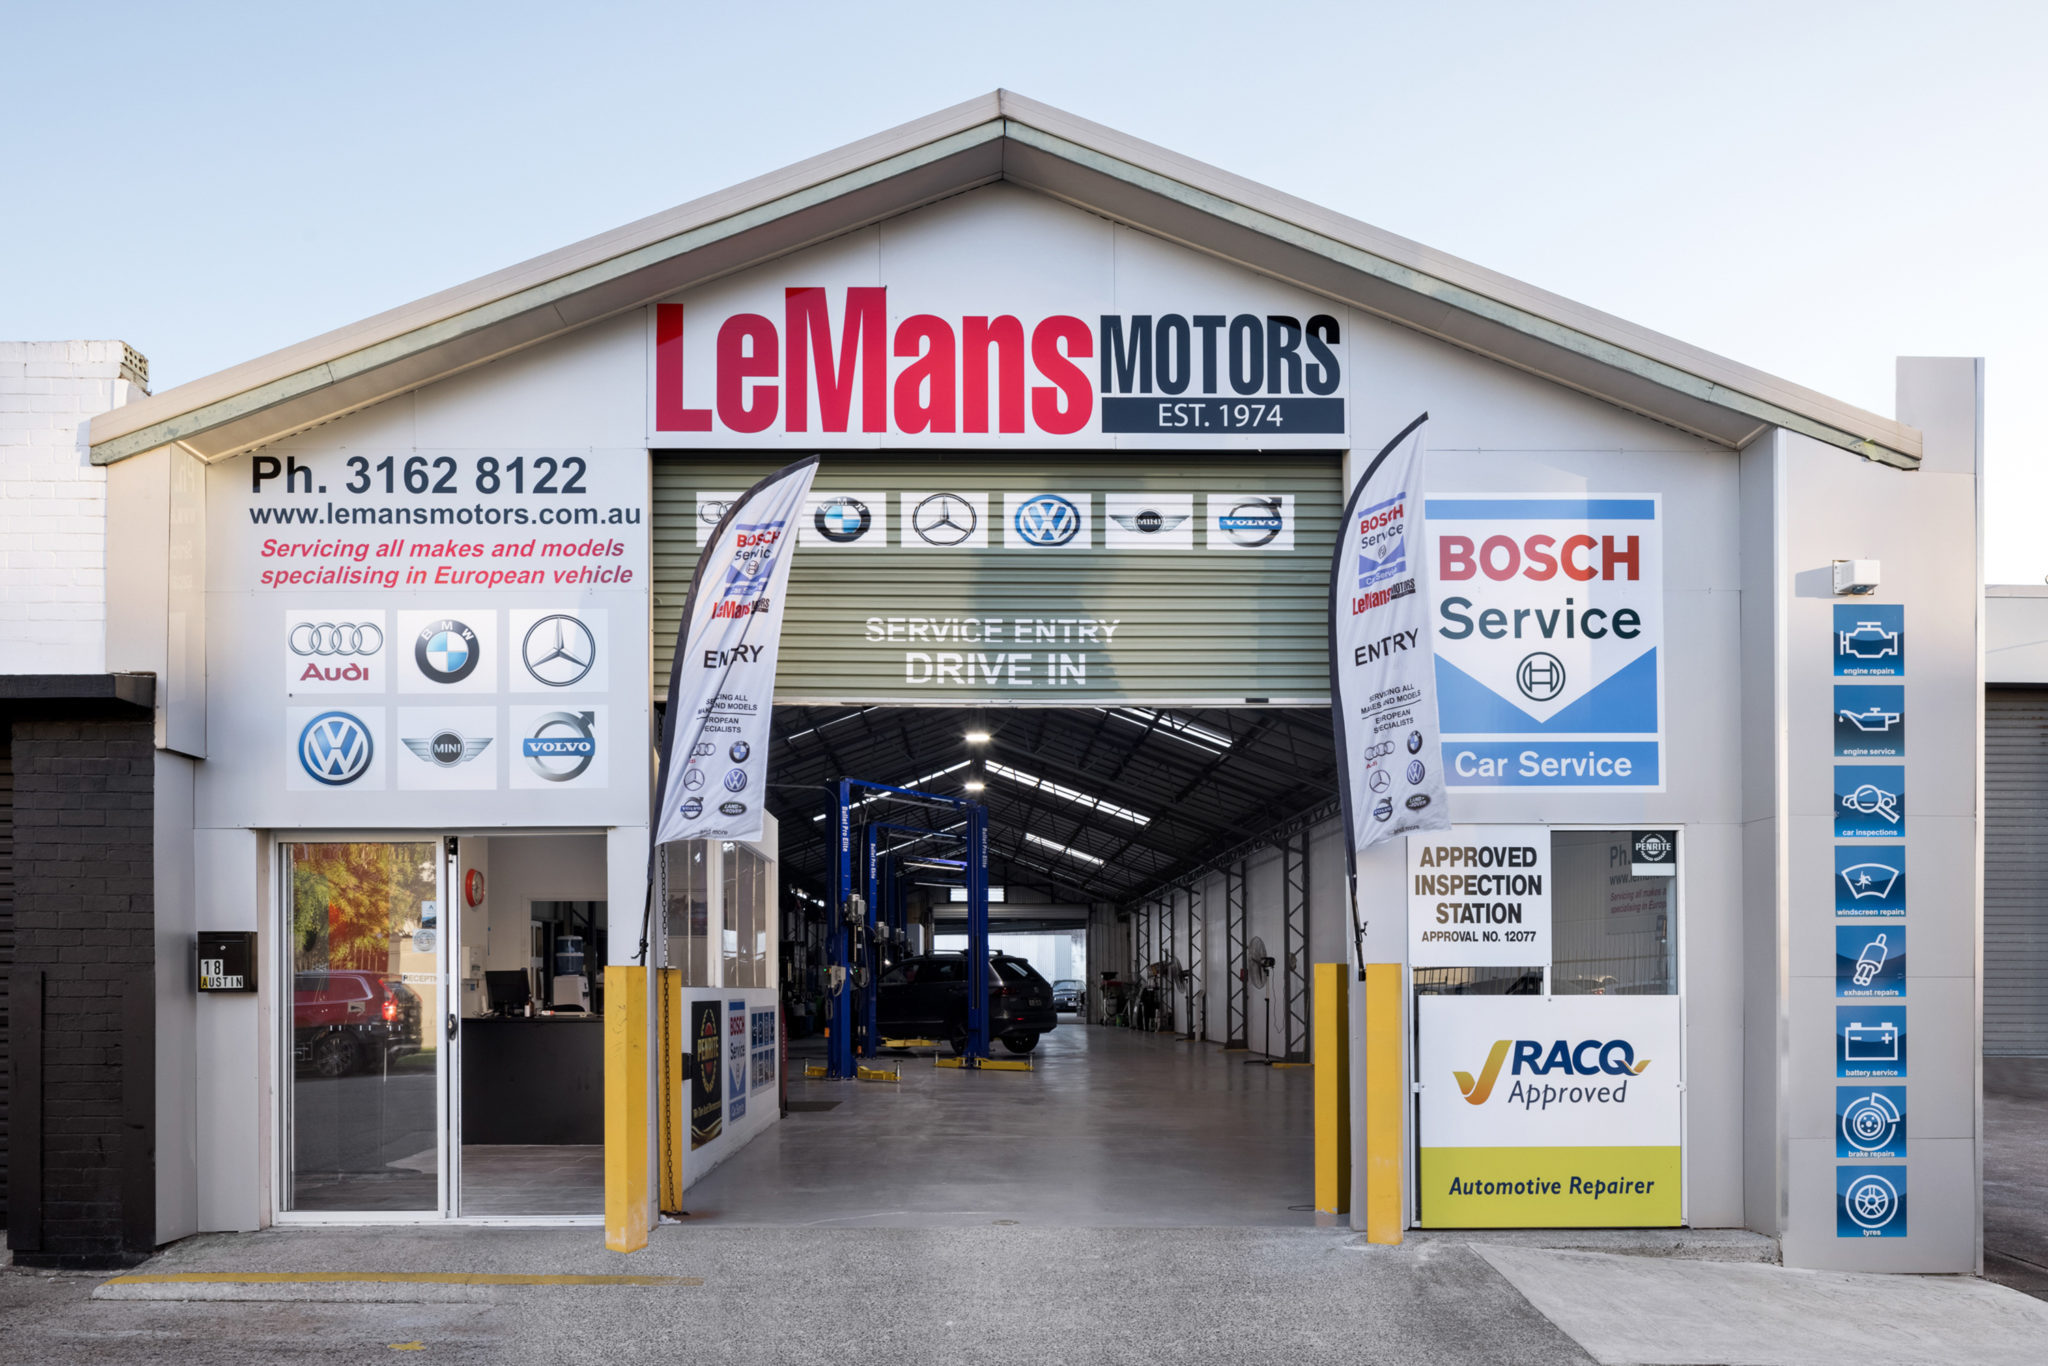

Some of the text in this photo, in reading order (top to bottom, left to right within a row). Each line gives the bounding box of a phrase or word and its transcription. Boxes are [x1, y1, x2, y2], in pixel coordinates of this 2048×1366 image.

[656, 287, 1341, 436] LeMans MOTORS
[1159, 404, 1283, 428] EST. 1974
[252, 456, 586, 494] Ph. 3162 8122
[249, 503, 641, 525] www.lemansmotors.com.au
[1137, 517, 1162, 525] MINI
[1222, 519, 1278, 527] VOLVO
[1360, 504, 1404, 534] BOSCH
[260, 539, 624, 562] Servicing all makes and models
[736, 531, 781, 548] BOSCH
[735, 547, 773, 560] Servic
[1439, 534, 1639, 581] BOSCH
[260, 565, 633, 589] specialising in European vehicle
[1439, 596, 1641, 640] Service
[421, 621, 474, 640] BMW
[865, 617, 1120, 643] SERVICE ENTRY
[703, 644, 764, 669] ENTRY
[1354, 628, 1418, 666] ENTRY
[300, 663, 369, 681] Audi
[906, 652, 1086, 685] DRIVE IN
[728, 703, 758, 711] MODELS
[434, 743, 461, 753] MINI
[528, 742, 591, 752] VOLVO
[1455, 750, 1632, 778] Car Service
[1856, 829, 1898, 837] inspections
[1419, 846, 1537, 868] APPROVED
[1635, 843, 1671, 851] PENRITE
[1415, 874, 1542, 896] INSPECTION
[1436, 902, 1522, 924] STATION
[1880, 909, 1905, 917] repairs
[1422, 931, 1536, 942] APPROVAL NO. 12077
[204, 961, 221, 975] 18
[202, 977, 242, 988] AUSTIN
[1511, 1040, 1646, 1076] RACQ
[1846, 1070, 1871, 1078] battery
[1508, 1080, 1627, 1110] Approved
[1449, 1176, 1655, 1199] Automotive Repairer
